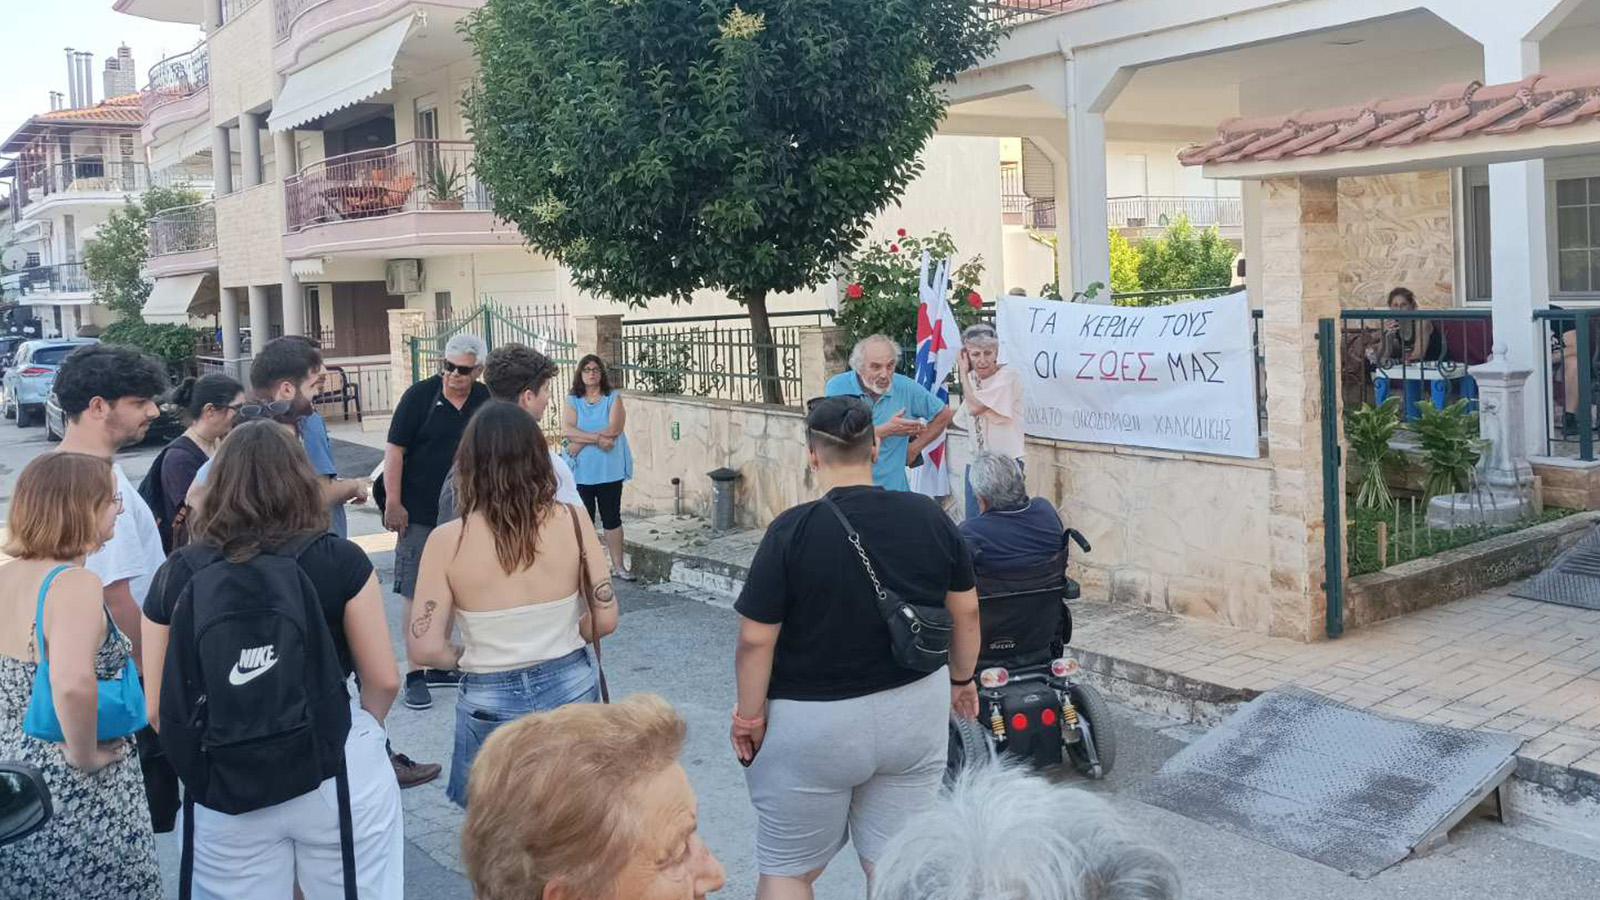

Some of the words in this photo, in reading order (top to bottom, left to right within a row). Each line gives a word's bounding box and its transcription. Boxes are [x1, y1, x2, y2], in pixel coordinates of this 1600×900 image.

[1029, 307, 1057, 334] ΤΑ
[1079, 314, 1145, 337] ΚΕΡΔΗ
[1159, 311, 1214, 337] ΤΟΥΣ
[1034, 350, 1058, 379] ΟΙ
[1075, 350, 1158, 381] ΖΩΕΣ
[1167, 352, 1225, 383] ΜΑΣ
[1152, 414, 1231, 440] ΧΑΛΚΙΔΙΚΗΣ
[239, 645, 274, 668] NIKE
